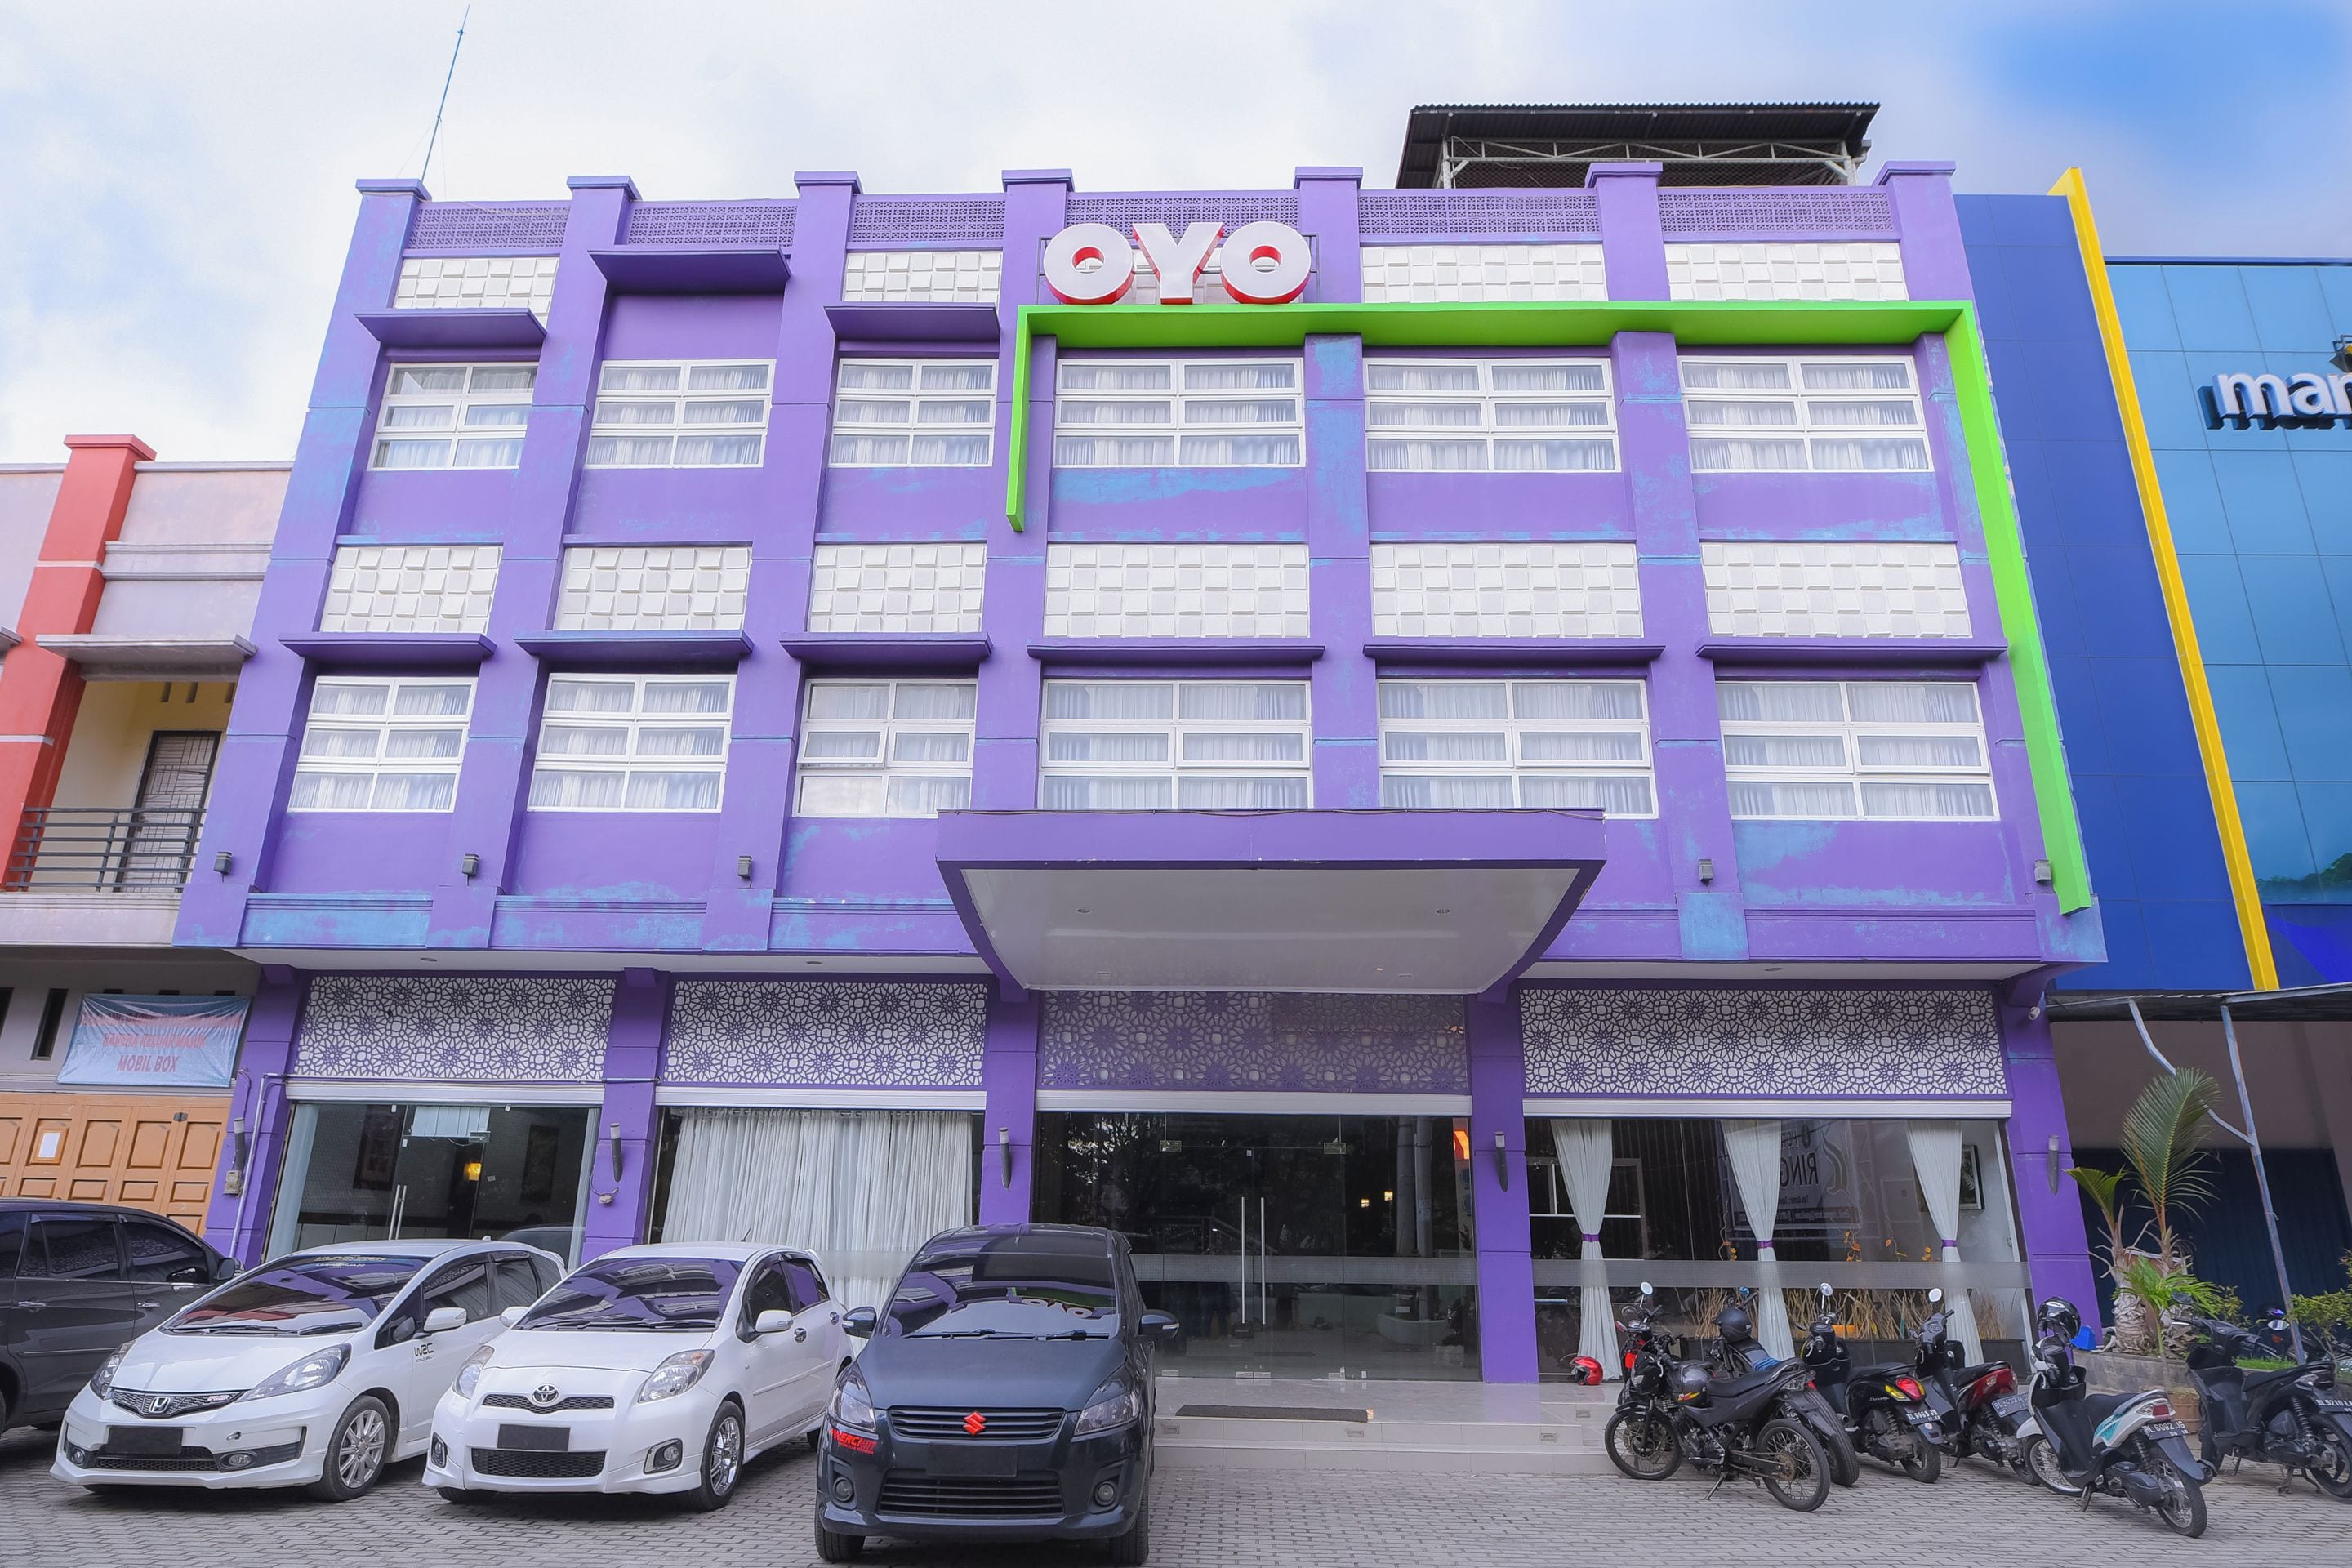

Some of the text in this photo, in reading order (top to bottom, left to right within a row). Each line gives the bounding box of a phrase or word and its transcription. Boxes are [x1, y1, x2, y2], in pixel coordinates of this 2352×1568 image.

[1044, 221, 1312, 303] OYO
[117, 1054, 179, 1072] MOBIL BOX
[413, 1343, 434, 1356] WRC
[2141, 1425, 2155, 1433] BL
[2154, 1422, 2174, 1431] 6092
